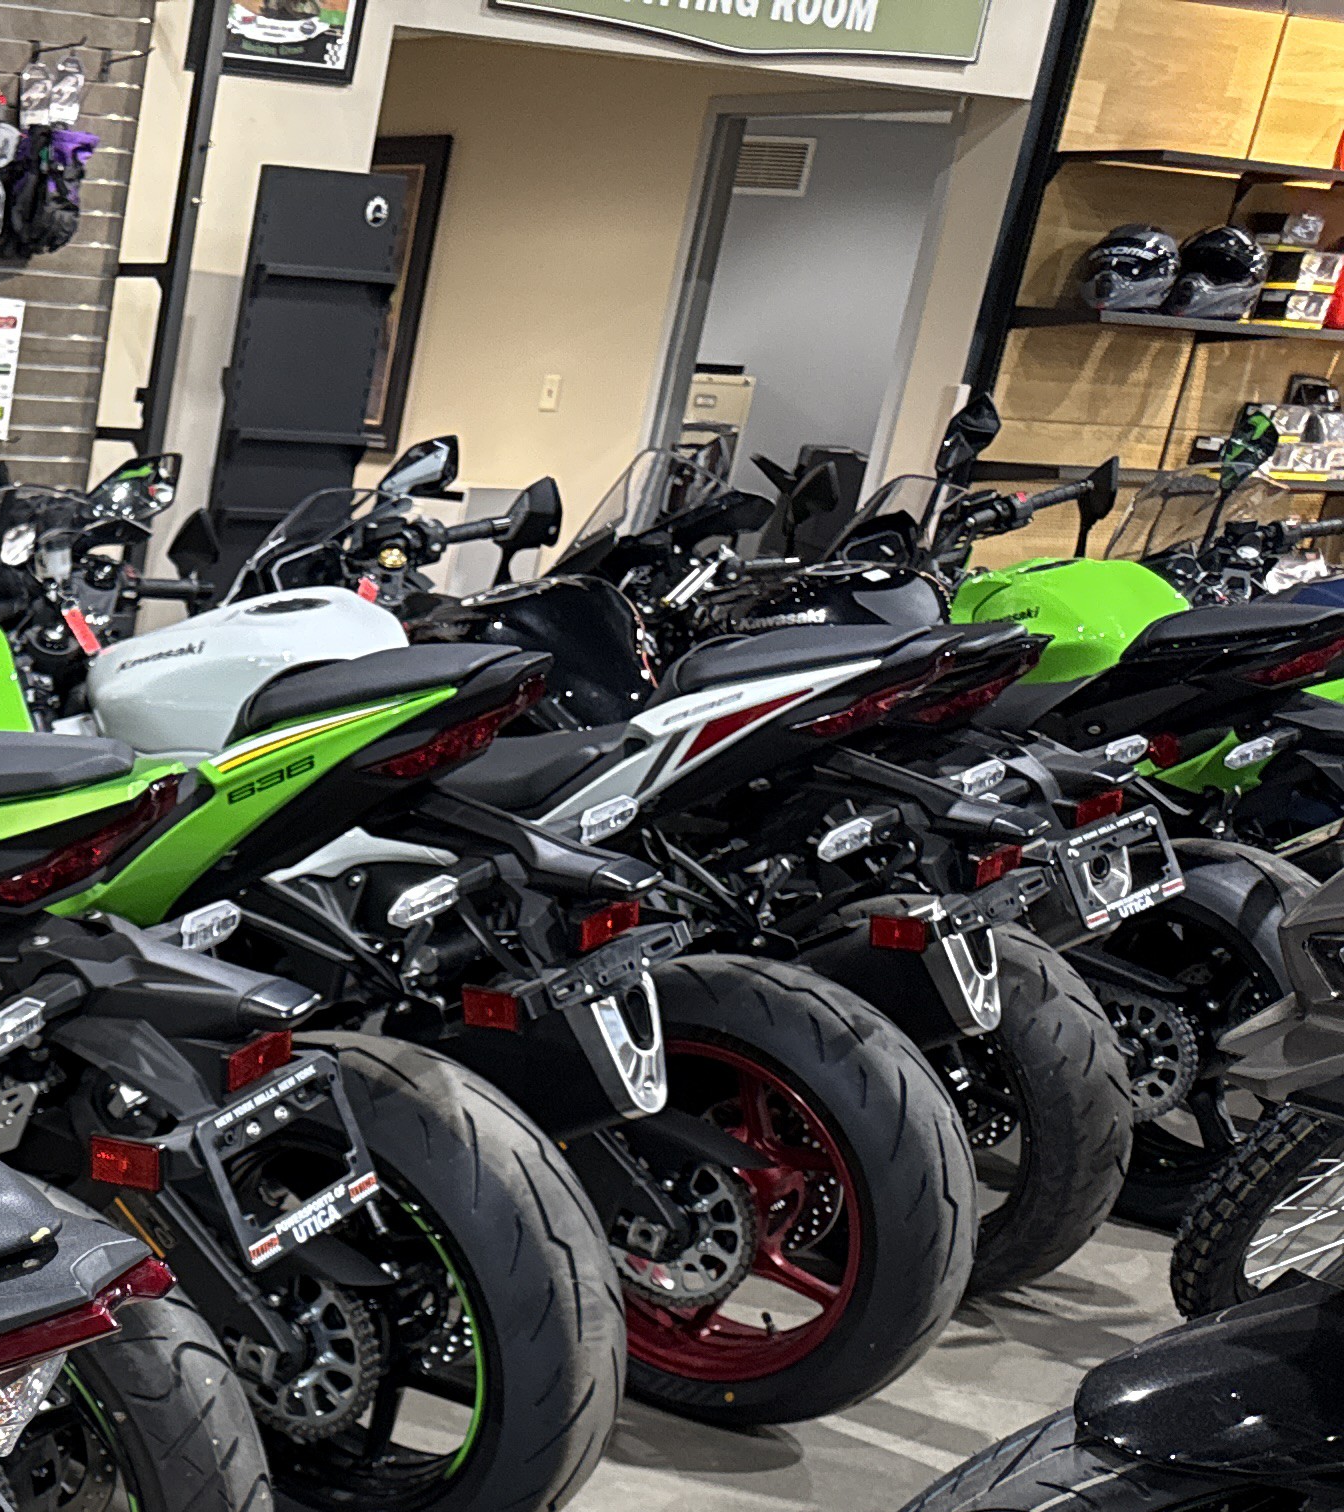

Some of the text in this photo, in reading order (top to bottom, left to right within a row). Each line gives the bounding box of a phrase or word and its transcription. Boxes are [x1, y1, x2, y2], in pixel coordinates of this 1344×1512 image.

[226, 754, 316, 806] 636
[1118, 895, 1155, 919] UTICA
[214, 1112, 235, 1129] NEW
[233, 1100, 255, 1118] YORK
[277, 1075, 297, 1093] NEW
[294, 1064, 317, 1083] YORK
[274, 1183, 346, 1235] POWERSPORTS OF
[291, 1203, 342, 1243] UTICA
